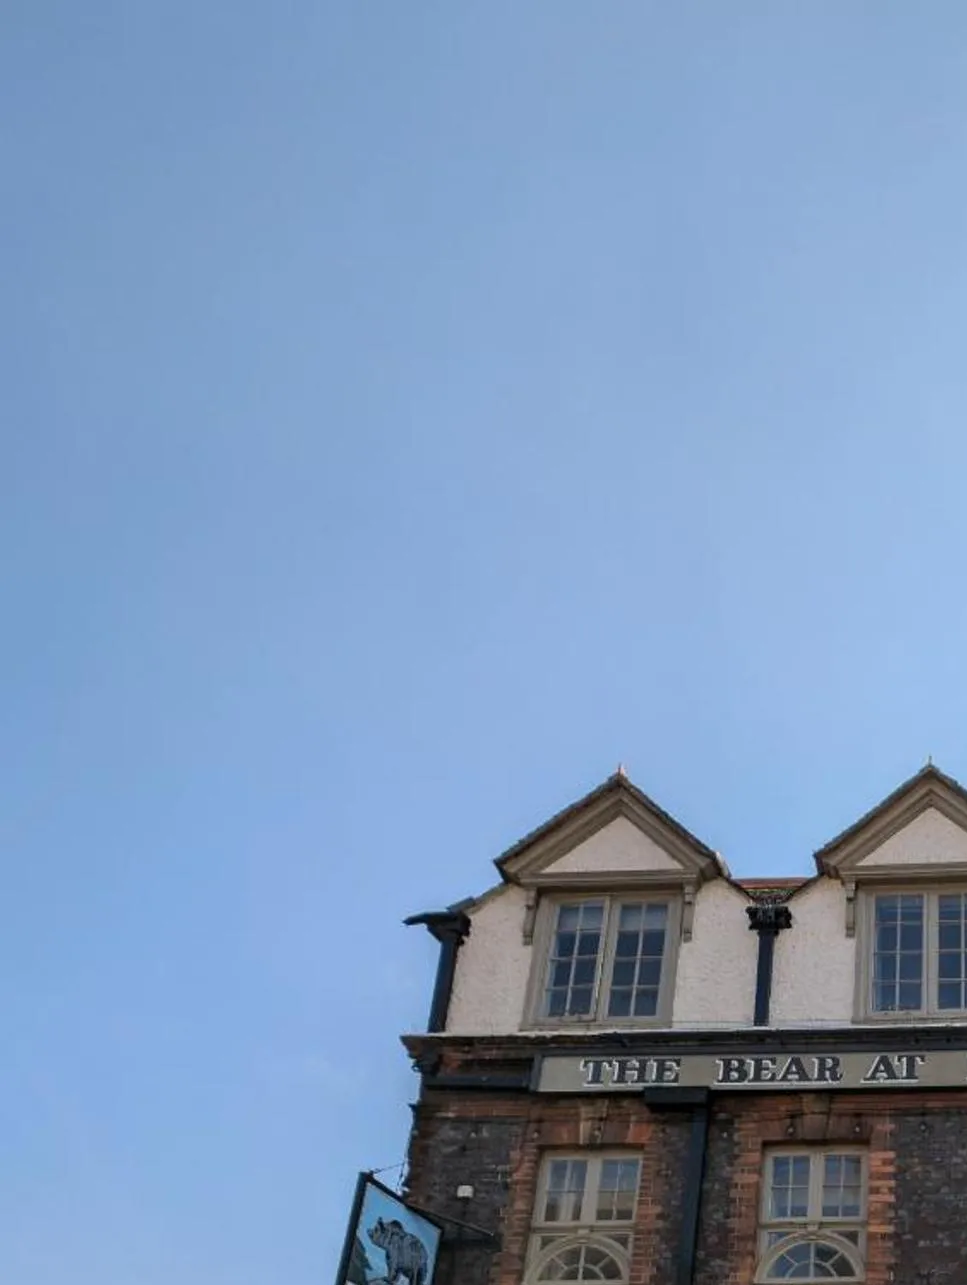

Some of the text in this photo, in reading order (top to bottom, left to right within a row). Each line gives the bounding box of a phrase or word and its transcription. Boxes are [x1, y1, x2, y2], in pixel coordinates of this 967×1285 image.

[581, 1057, 681, 1086] THE
[713, 1055, 844, 1085] BEAR
[860, 1054, 926, 1083] AT
